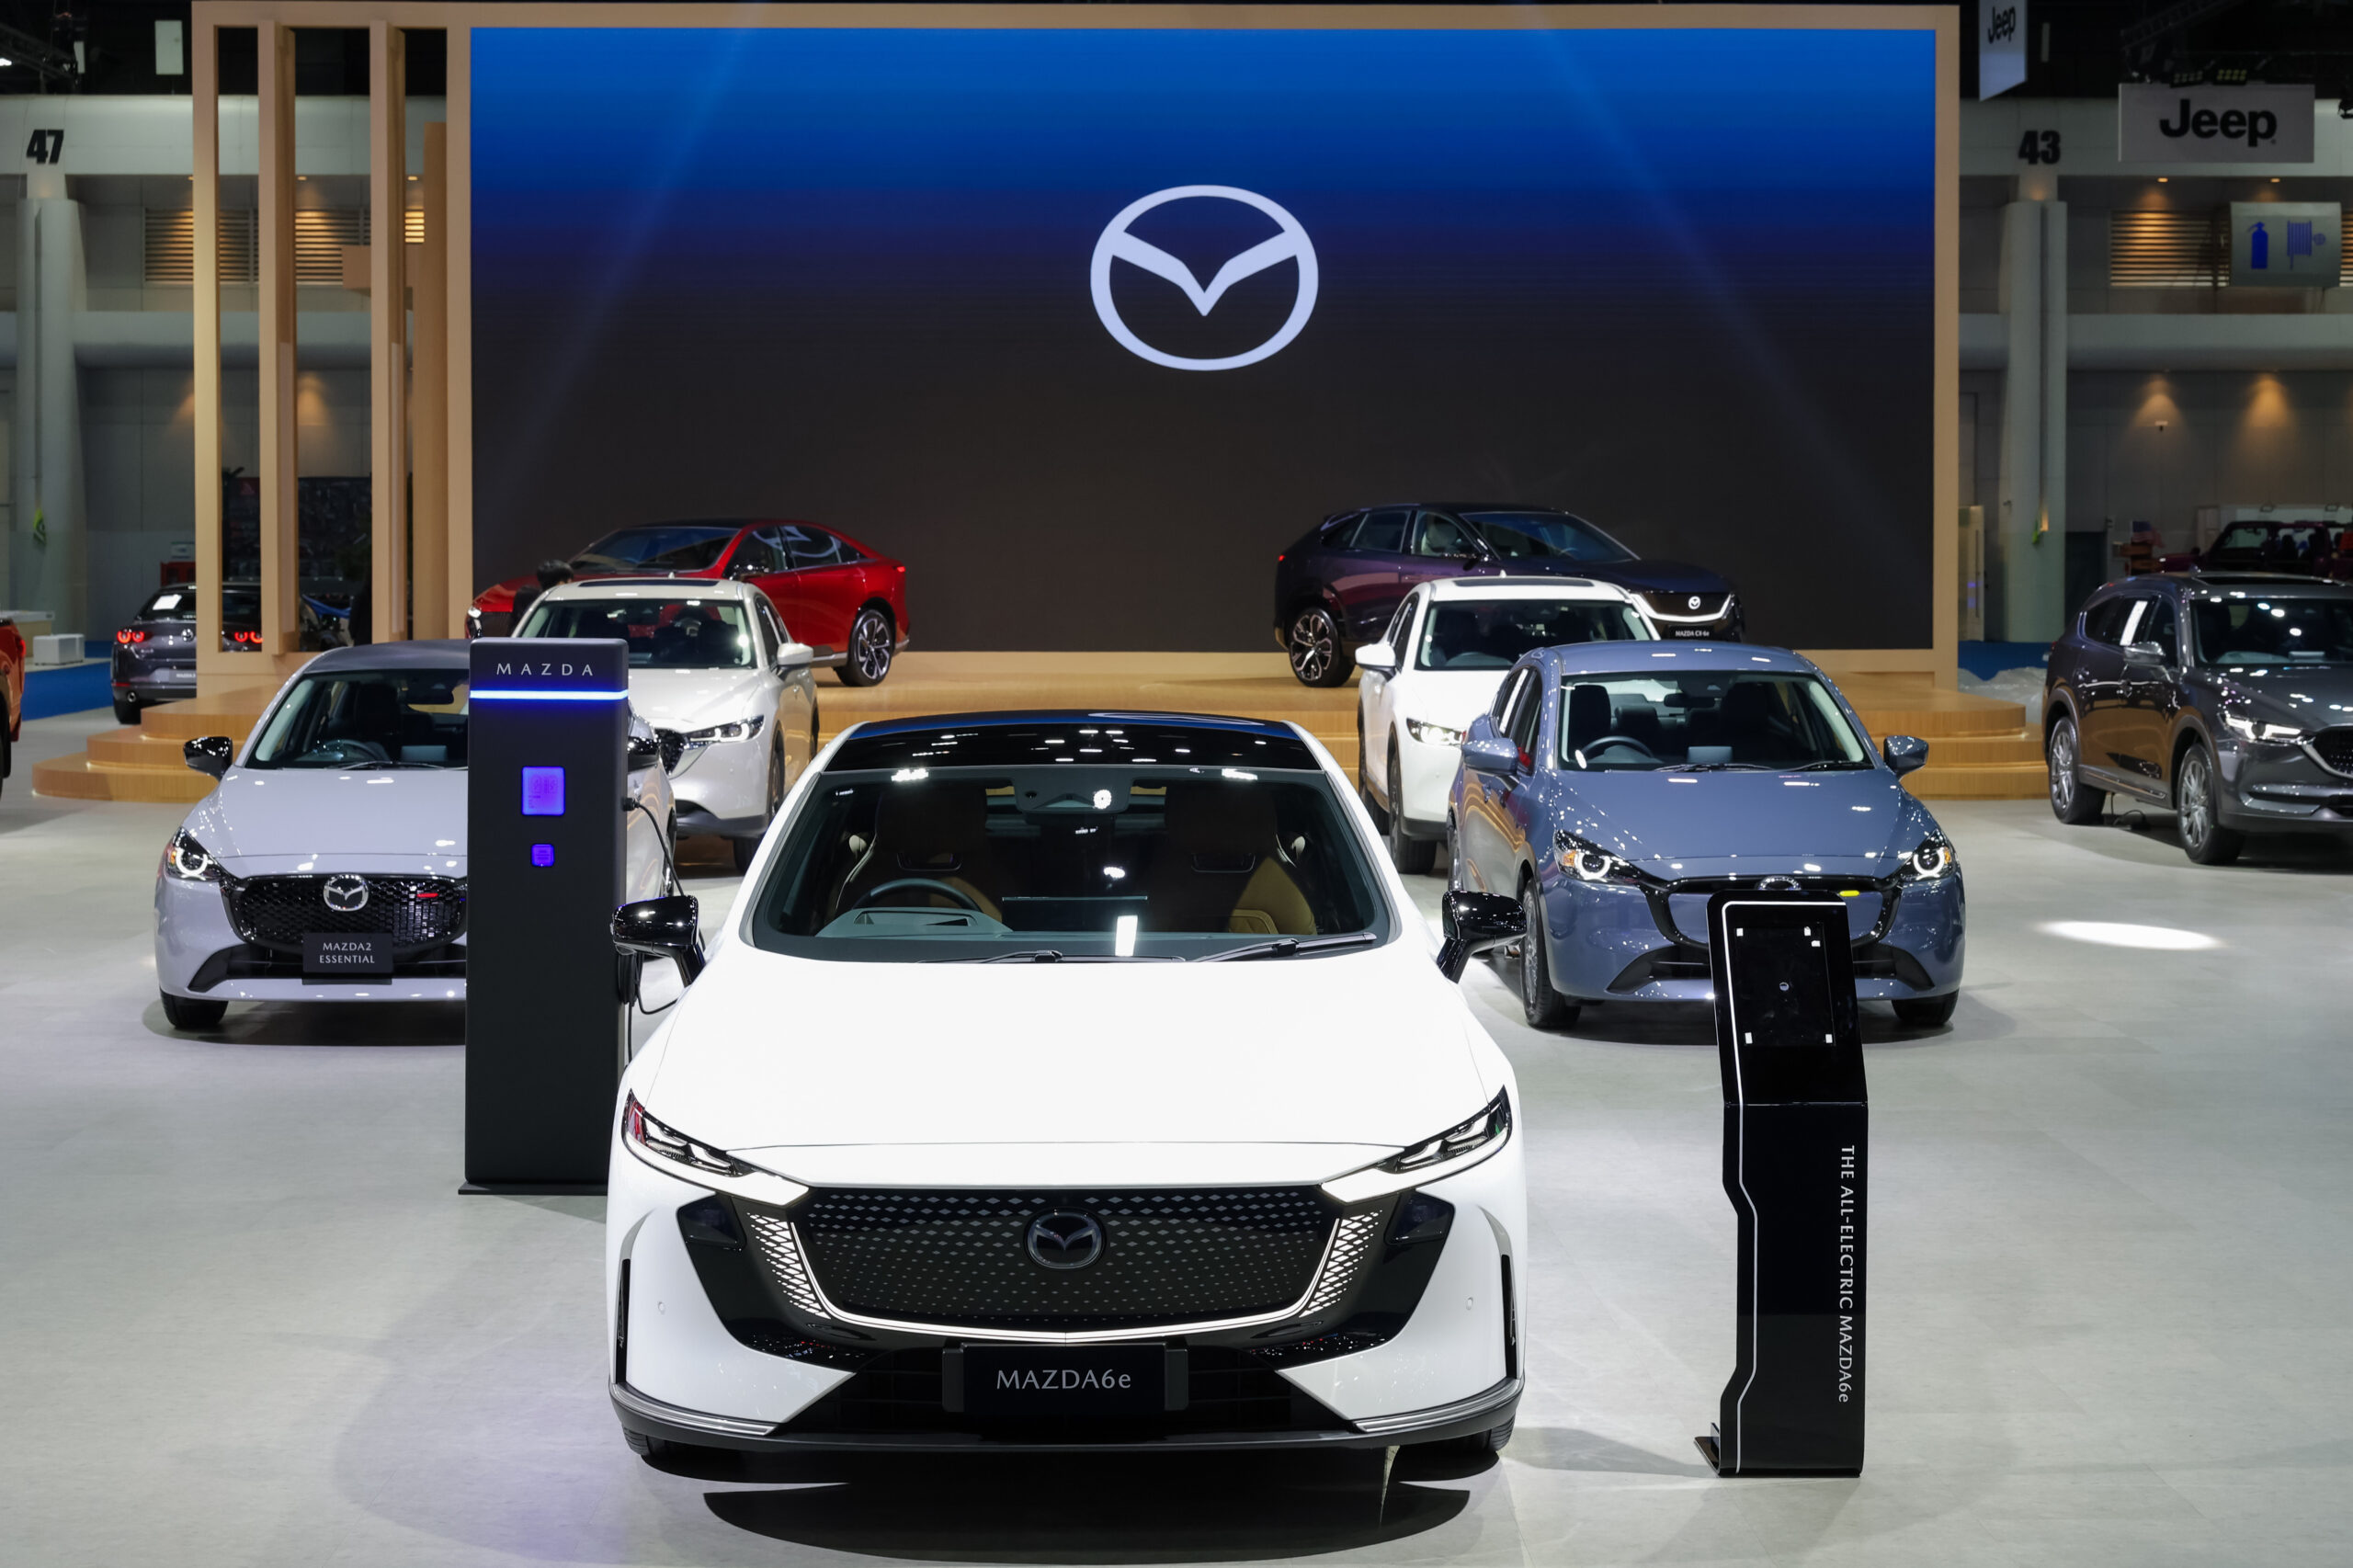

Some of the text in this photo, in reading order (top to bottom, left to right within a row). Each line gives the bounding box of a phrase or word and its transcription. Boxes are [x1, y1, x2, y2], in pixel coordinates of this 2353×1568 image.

[1987, 6, 2016, 44] Jeep
[2159, 98, 2278, 147] Jeep
[26, 129, 64, 165] 47
[2018, 130, 2061, 165] 43
[496, 663, 594, 676] MAZDA
[319, 954, 375, 964] ESSENTIAL
[323, 942, 372, 951] MAZDA2
[1838, 1145, 1855, 1403] THE ALL-ELECTRIC MAZDA6e
[996, 1369, 1131, 1390] MAZDA6e
